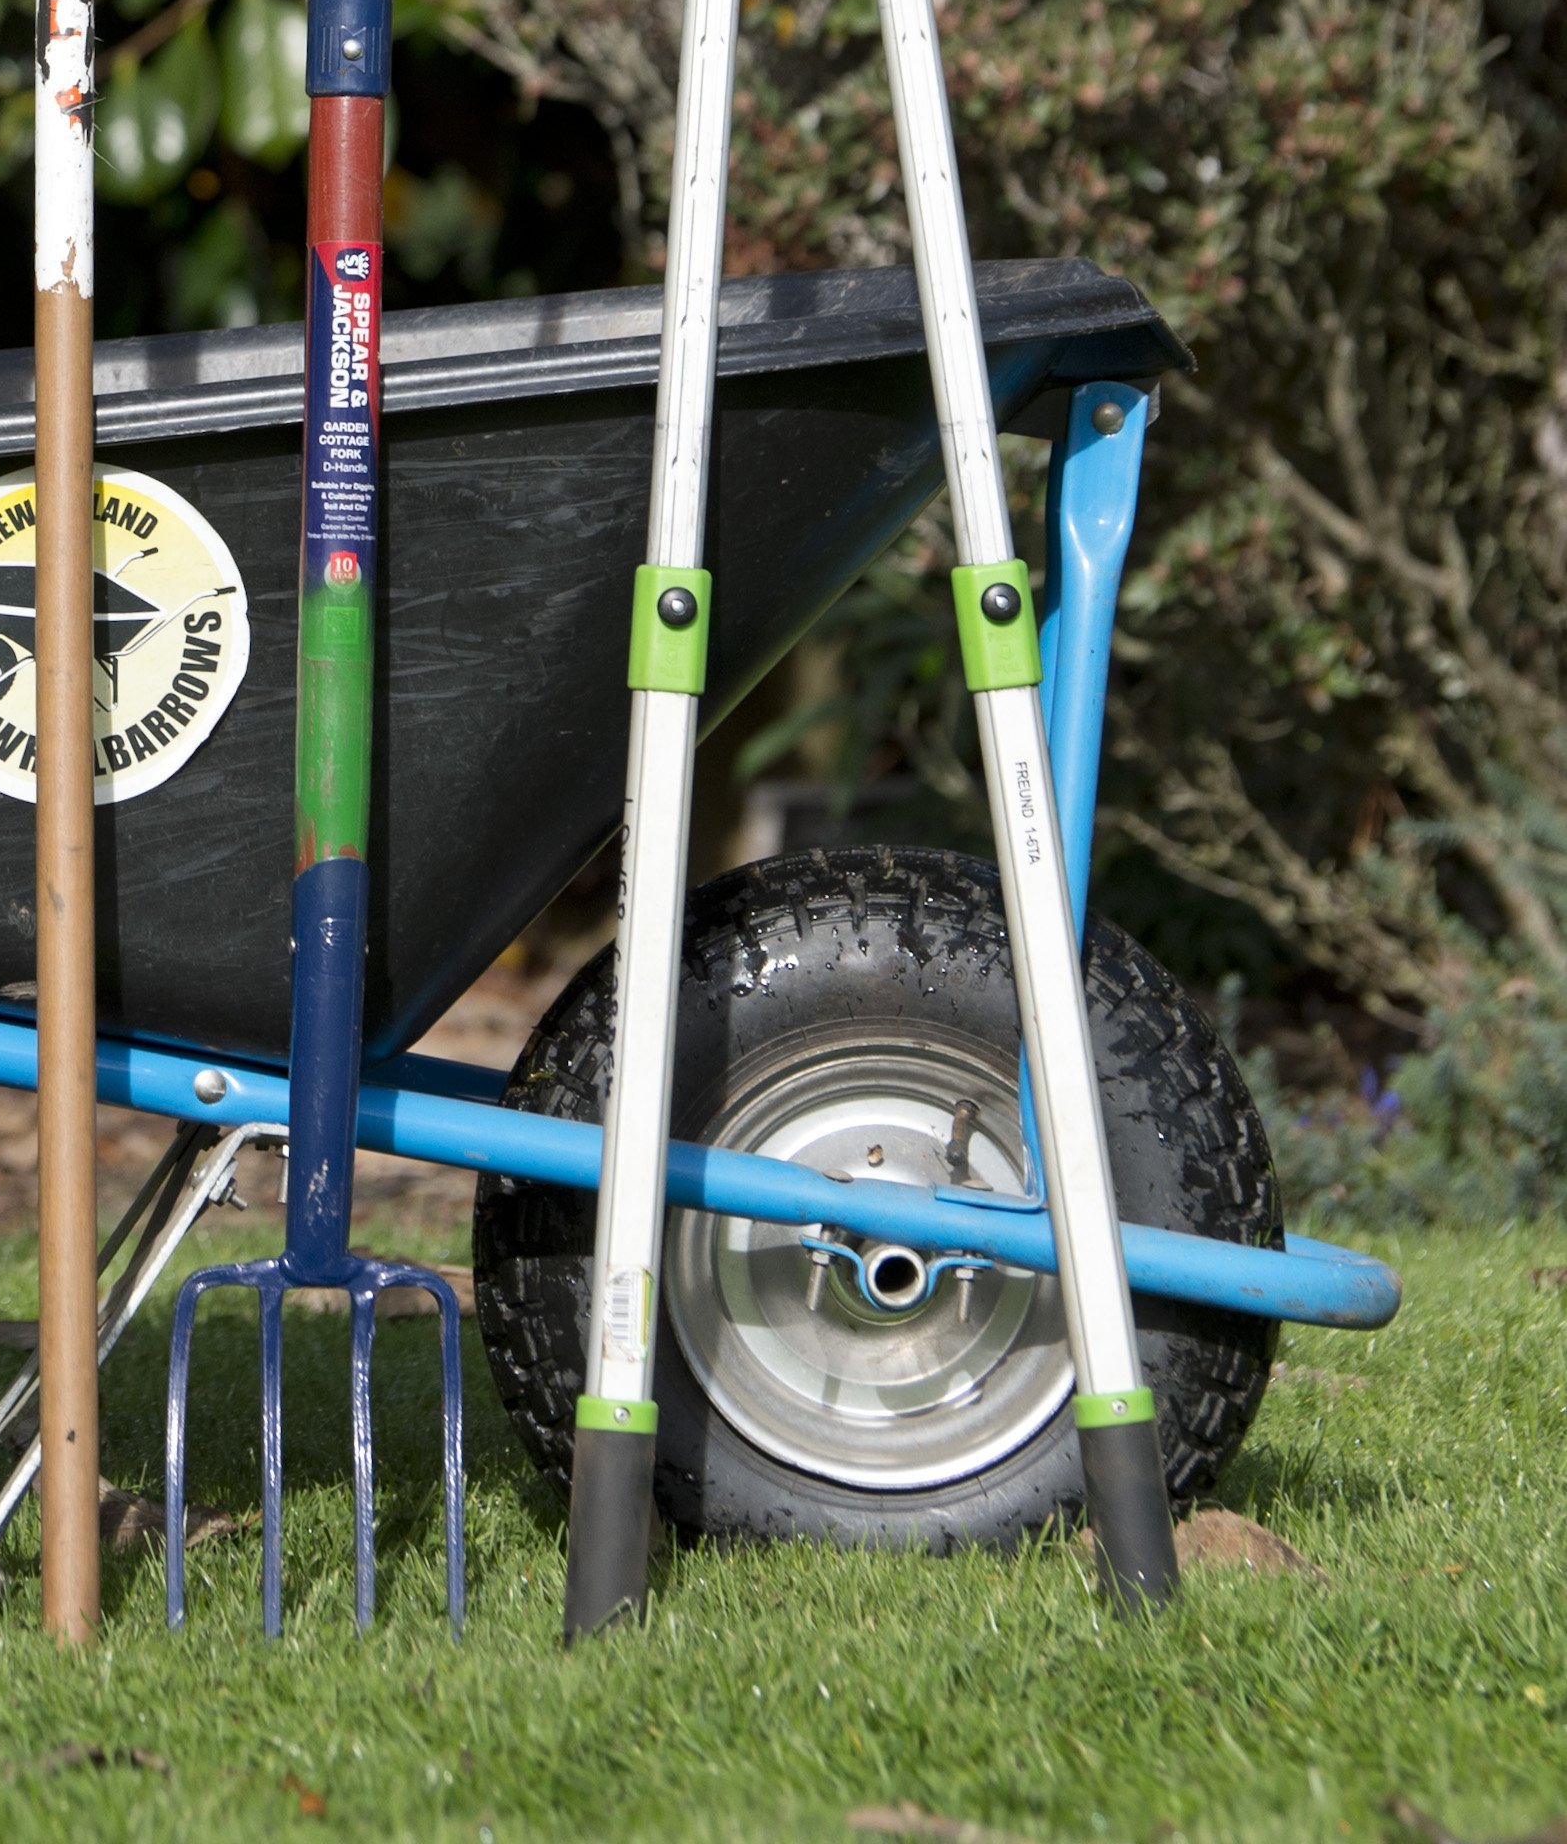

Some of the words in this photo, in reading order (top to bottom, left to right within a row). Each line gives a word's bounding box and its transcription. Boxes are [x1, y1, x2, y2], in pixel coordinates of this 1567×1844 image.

[351, 292, 370, 381] SPEAR
[330, 284, 352, 409] JACKSON
[351, 389, 368, 408] &
[323, 421, 369, 433] GARDEN
[318, 434, 370, 446] COTTAGE
[330, 448, 362, 460] FORK
[322, 461, 368, 473] D-Handle
[311, 481, 339, 489] Suitable
[339, 482, 353, 490] For
[327, 492, 365, 502] Cultivating
[323, 502, 338, 510] Soil
[338, 503, 354, 511] And
[354, 503, 369, 512] Clay
[335, 557, 354, 572] 10
[333, 571, 354, 580] YEAR
[1015, 761, 1035, 818] FREUND
